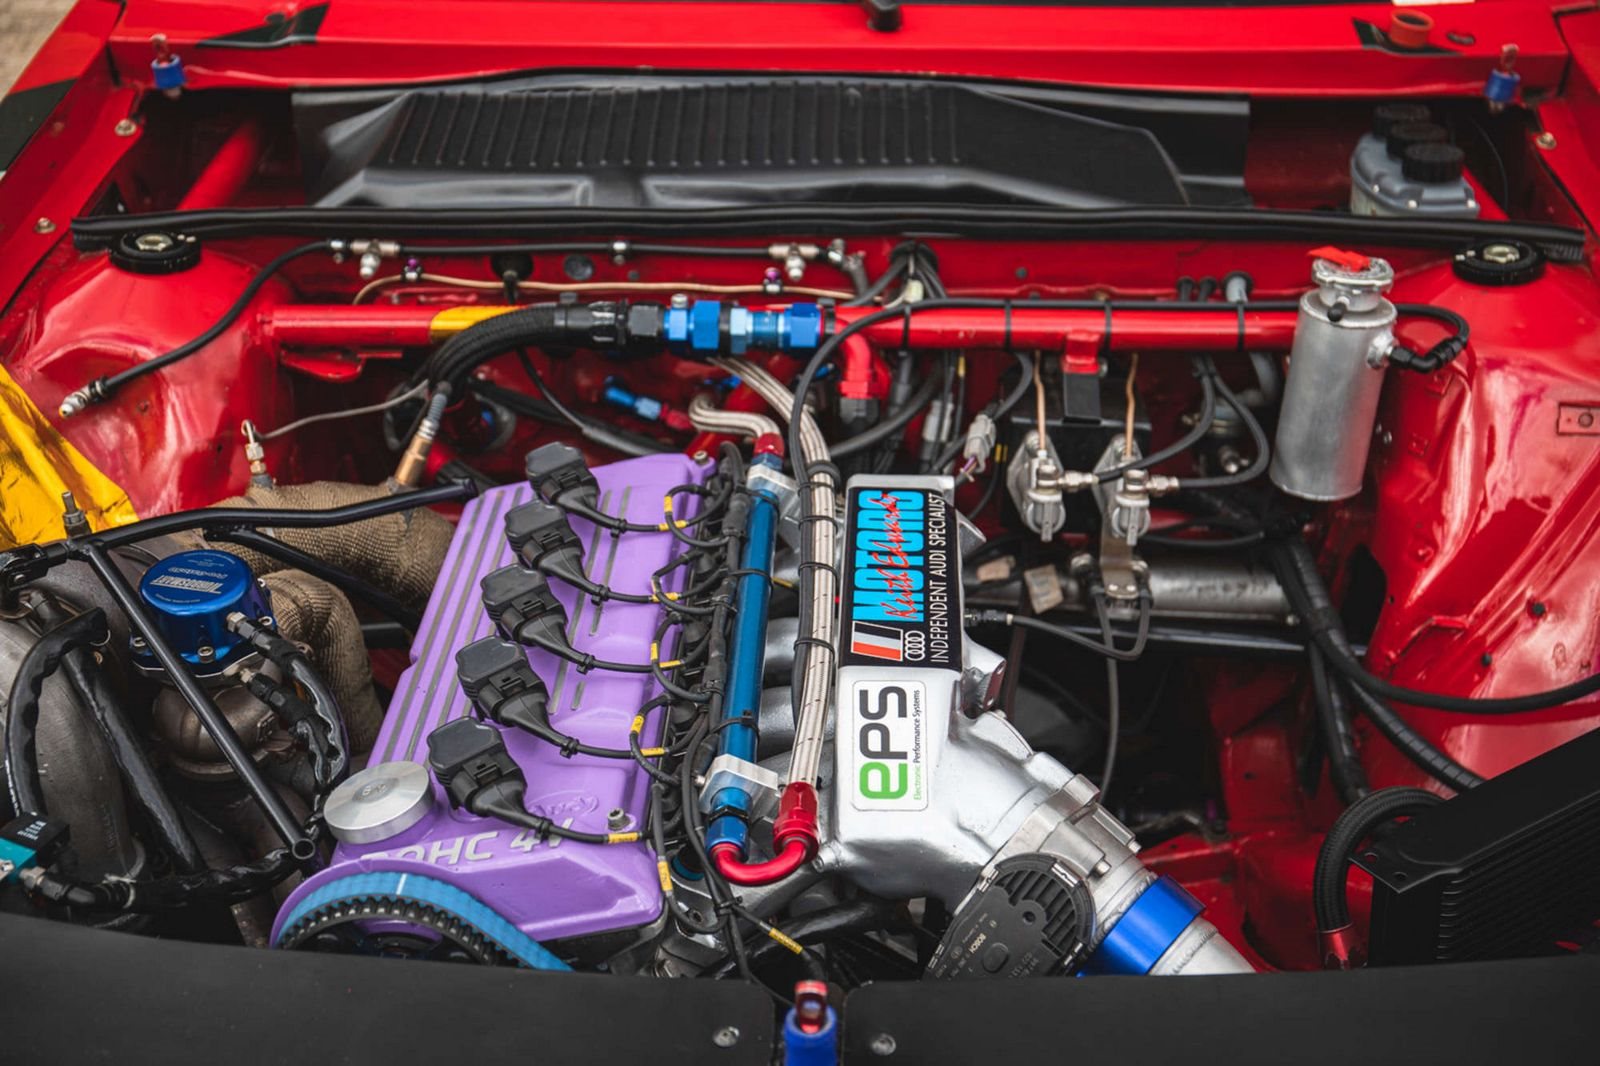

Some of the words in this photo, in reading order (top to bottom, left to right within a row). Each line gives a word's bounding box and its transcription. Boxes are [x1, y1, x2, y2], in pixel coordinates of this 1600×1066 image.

[869, 493, 909, 568] Edwards
[928, 493, 946, 546] SPECIALIST
[852, 490, 925, 622] MOTORS
[929, 550, 947, 577] AUDI
[877, 568, 918, 619] Keith
[929, 580, 949, 663] INDEPENDENT
[912, 690, 922, 717] Systems
[912, 718, 921, 763] Performance
[360, 831, 498, 865] OHC
[968, 933, 986, 954] BOSCH
